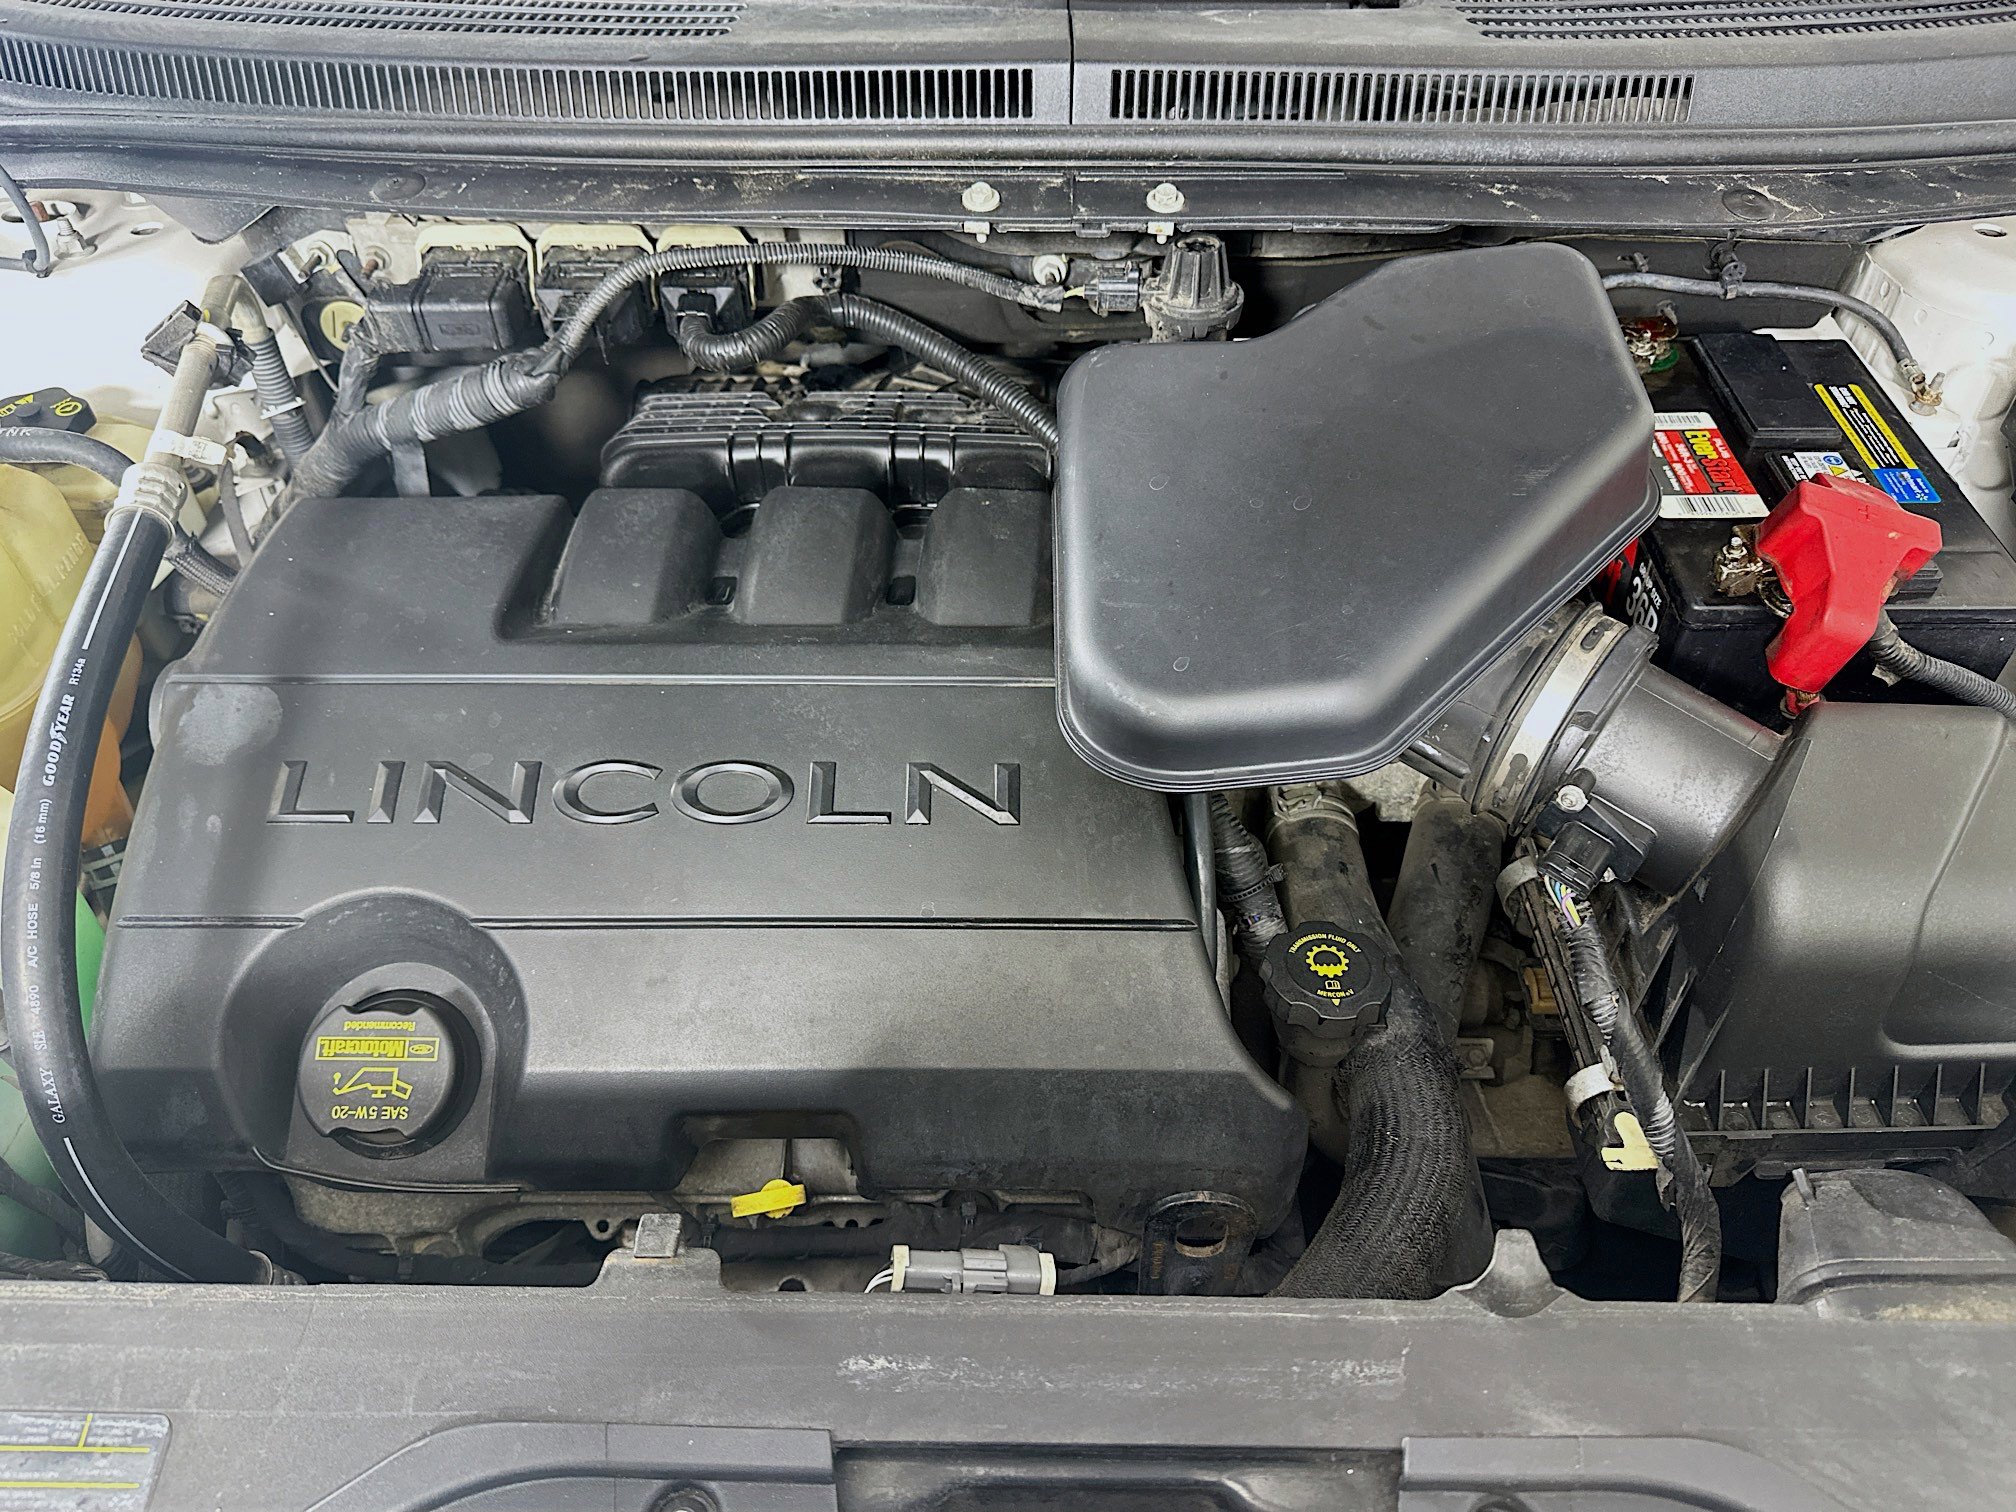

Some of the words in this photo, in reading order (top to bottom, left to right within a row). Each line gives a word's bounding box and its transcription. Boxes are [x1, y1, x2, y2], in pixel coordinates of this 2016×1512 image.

[1712, 437, 1731, 459] PLUS
[1683, 430, 1743, 493] EverStart
[68, 657, 87, 685] R134a
[42, 694, 75, 786] GOODYEAR
[265, 760, 1020, 825] LINCOLN
[38, 798, 52, 824] mm)
[33, 826, 47, 844] (16
[31, 857, 42, 869] in
[31, 872, 41, 890] 5/8
[27, 903, 39, 939] HOSE
[1288, 934, 1327, 954] TRANSMISSION
[1328, 934, 1347, 943] FLUID
[1346, 941, 1362, 953] ONLY
[27, 945, 38, 968] A/C
[29, 985, 41, 1014] 4890
[344, 1021, 416, 1031] Recommended
[34, 1031, 48, 1050] SLE
[323, 1039, 405, 1058] Motorcraft
[39, 1067, 67, 1123] GALAXY
[331, 1105, 378, 1120] 5W-20
[381, 1105, 409, 1120] SAE
